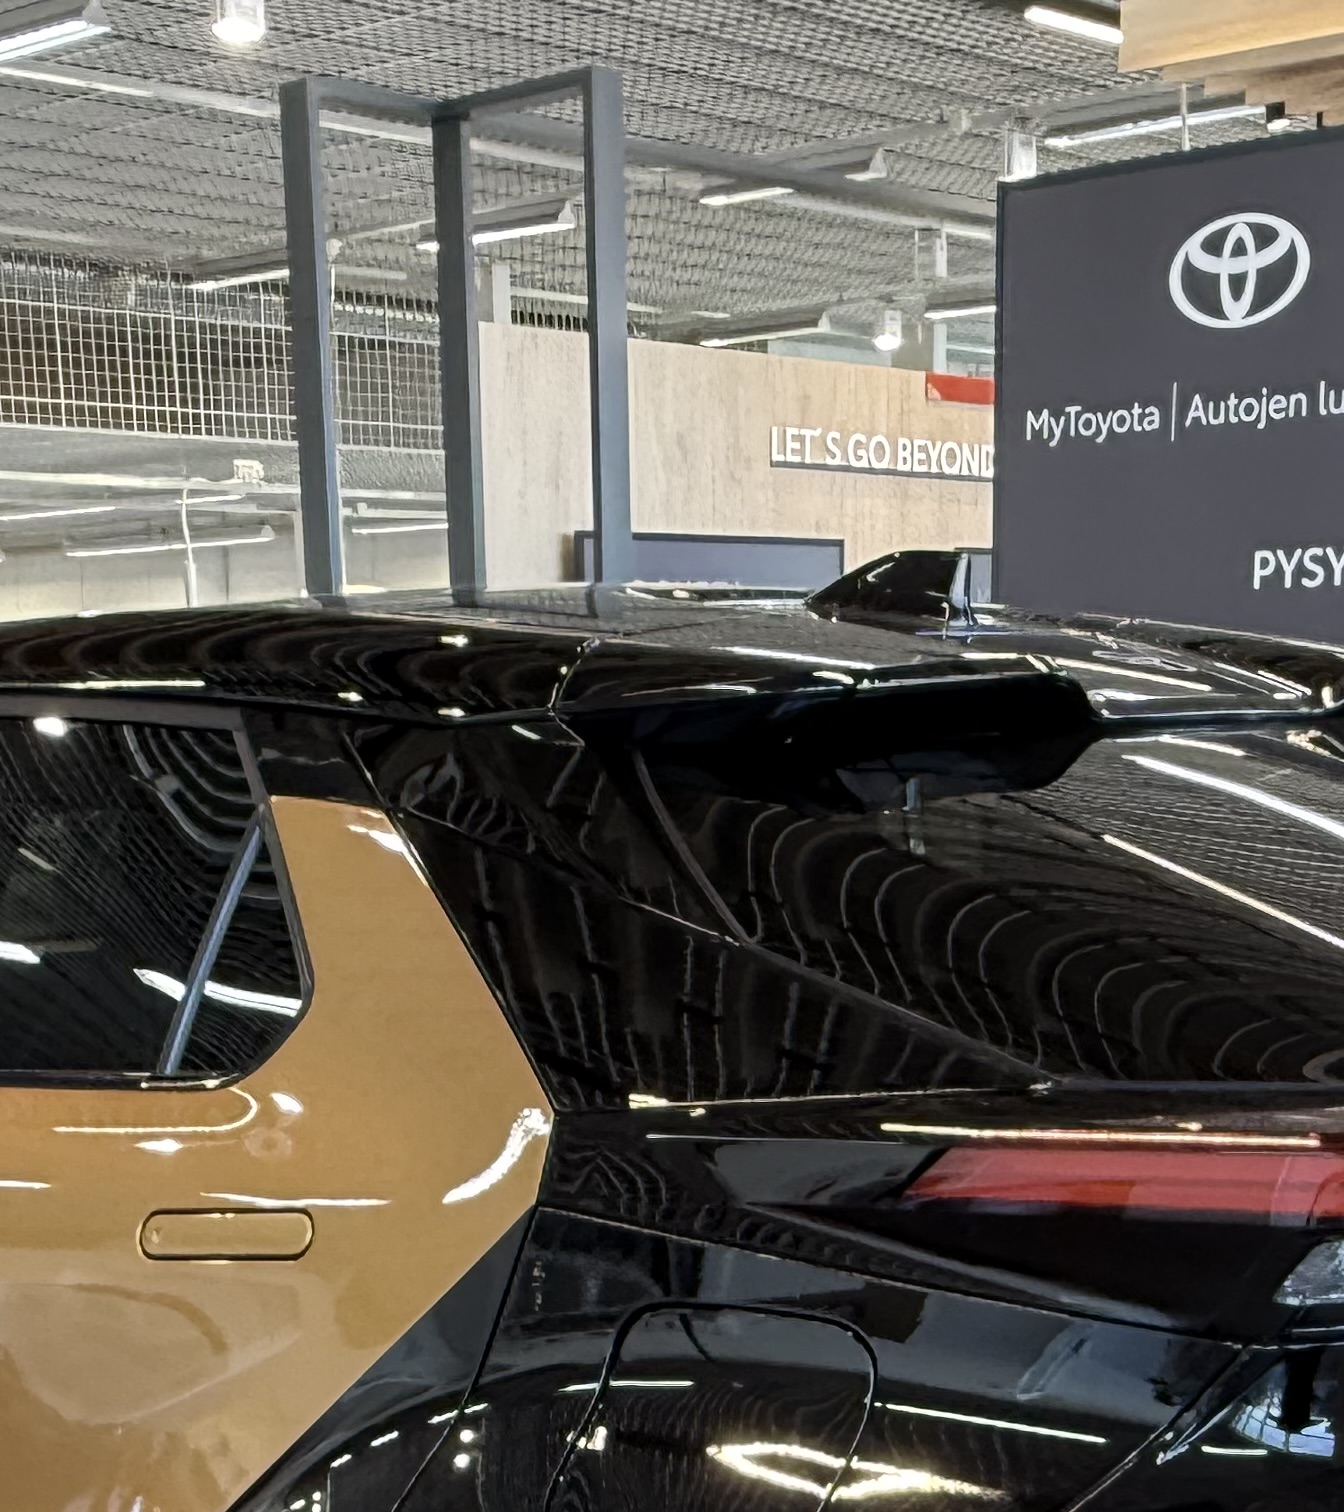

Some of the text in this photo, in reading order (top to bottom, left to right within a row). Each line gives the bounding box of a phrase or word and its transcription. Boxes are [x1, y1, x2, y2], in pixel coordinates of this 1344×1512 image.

[1026, 402, 1160, 448] MyToyota
[1184, 386, 1308, 430] Autojen
[847, 434, 890, 470] GO
[896, 437, 994, 478] BEYOND
